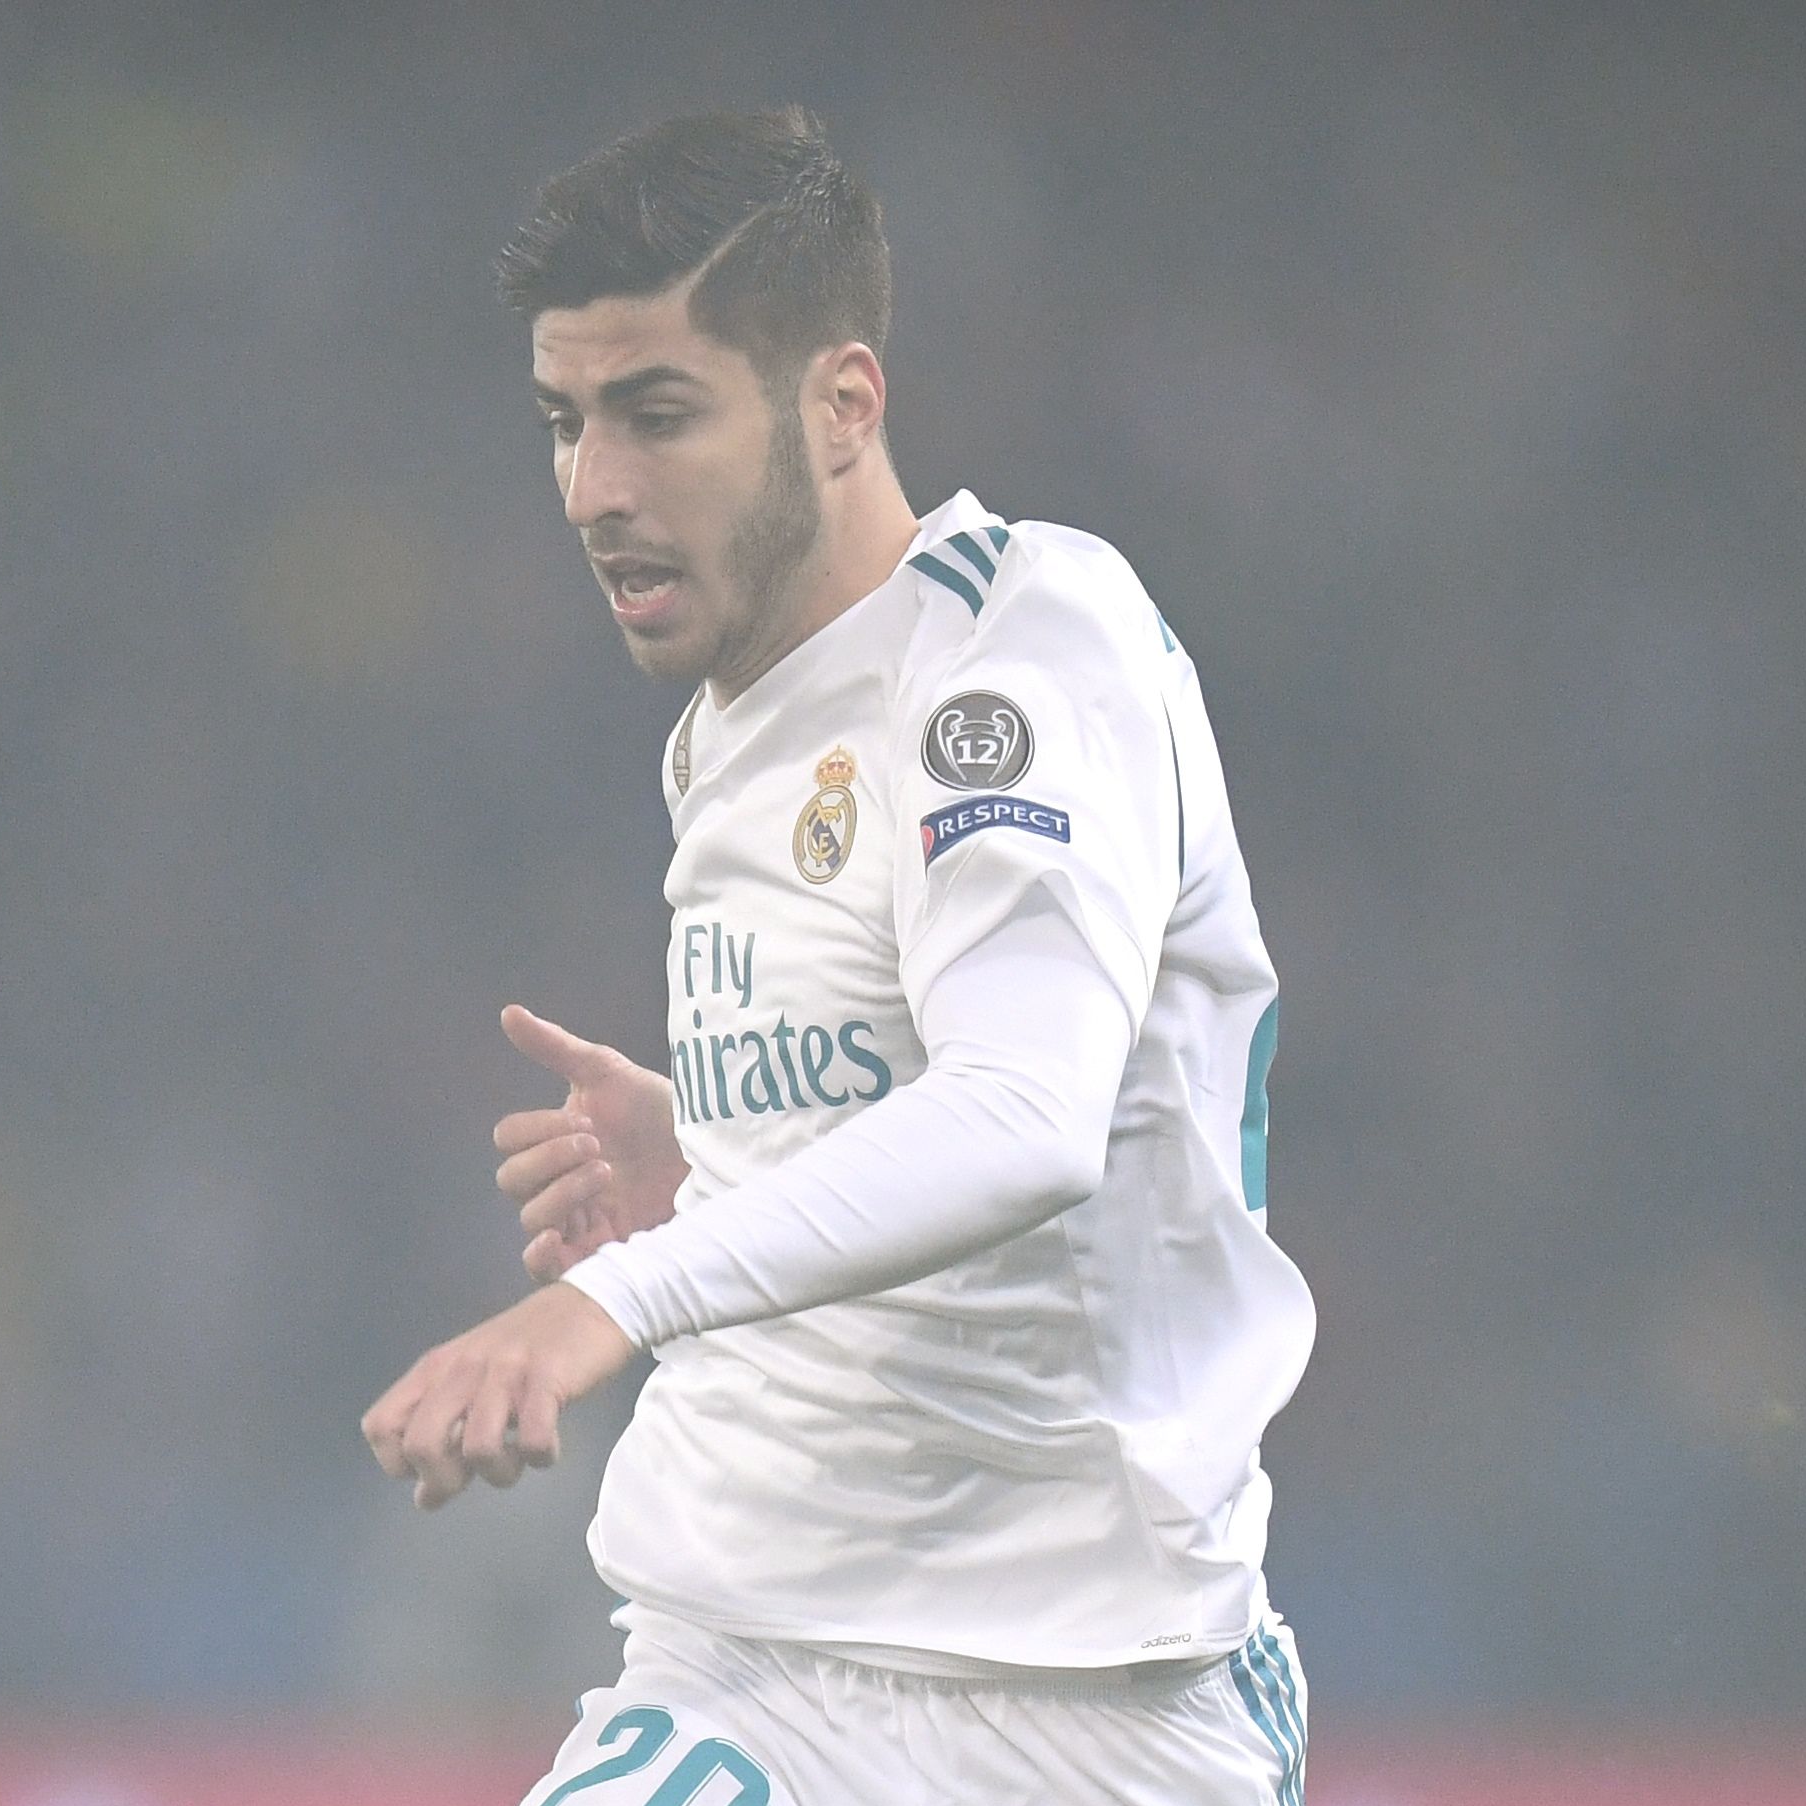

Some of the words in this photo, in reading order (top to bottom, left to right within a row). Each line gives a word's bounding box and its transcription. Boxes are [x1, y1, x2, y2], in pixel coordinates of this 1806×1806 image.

[957, 739, 998, 764] 12
[938, 804, 1067, 839] RESPECT
[684, 922, 755, 1008] Fly
[672, 1009, 892, 1124] mirates
[1141, 1633, 1191, 1648] adizero
